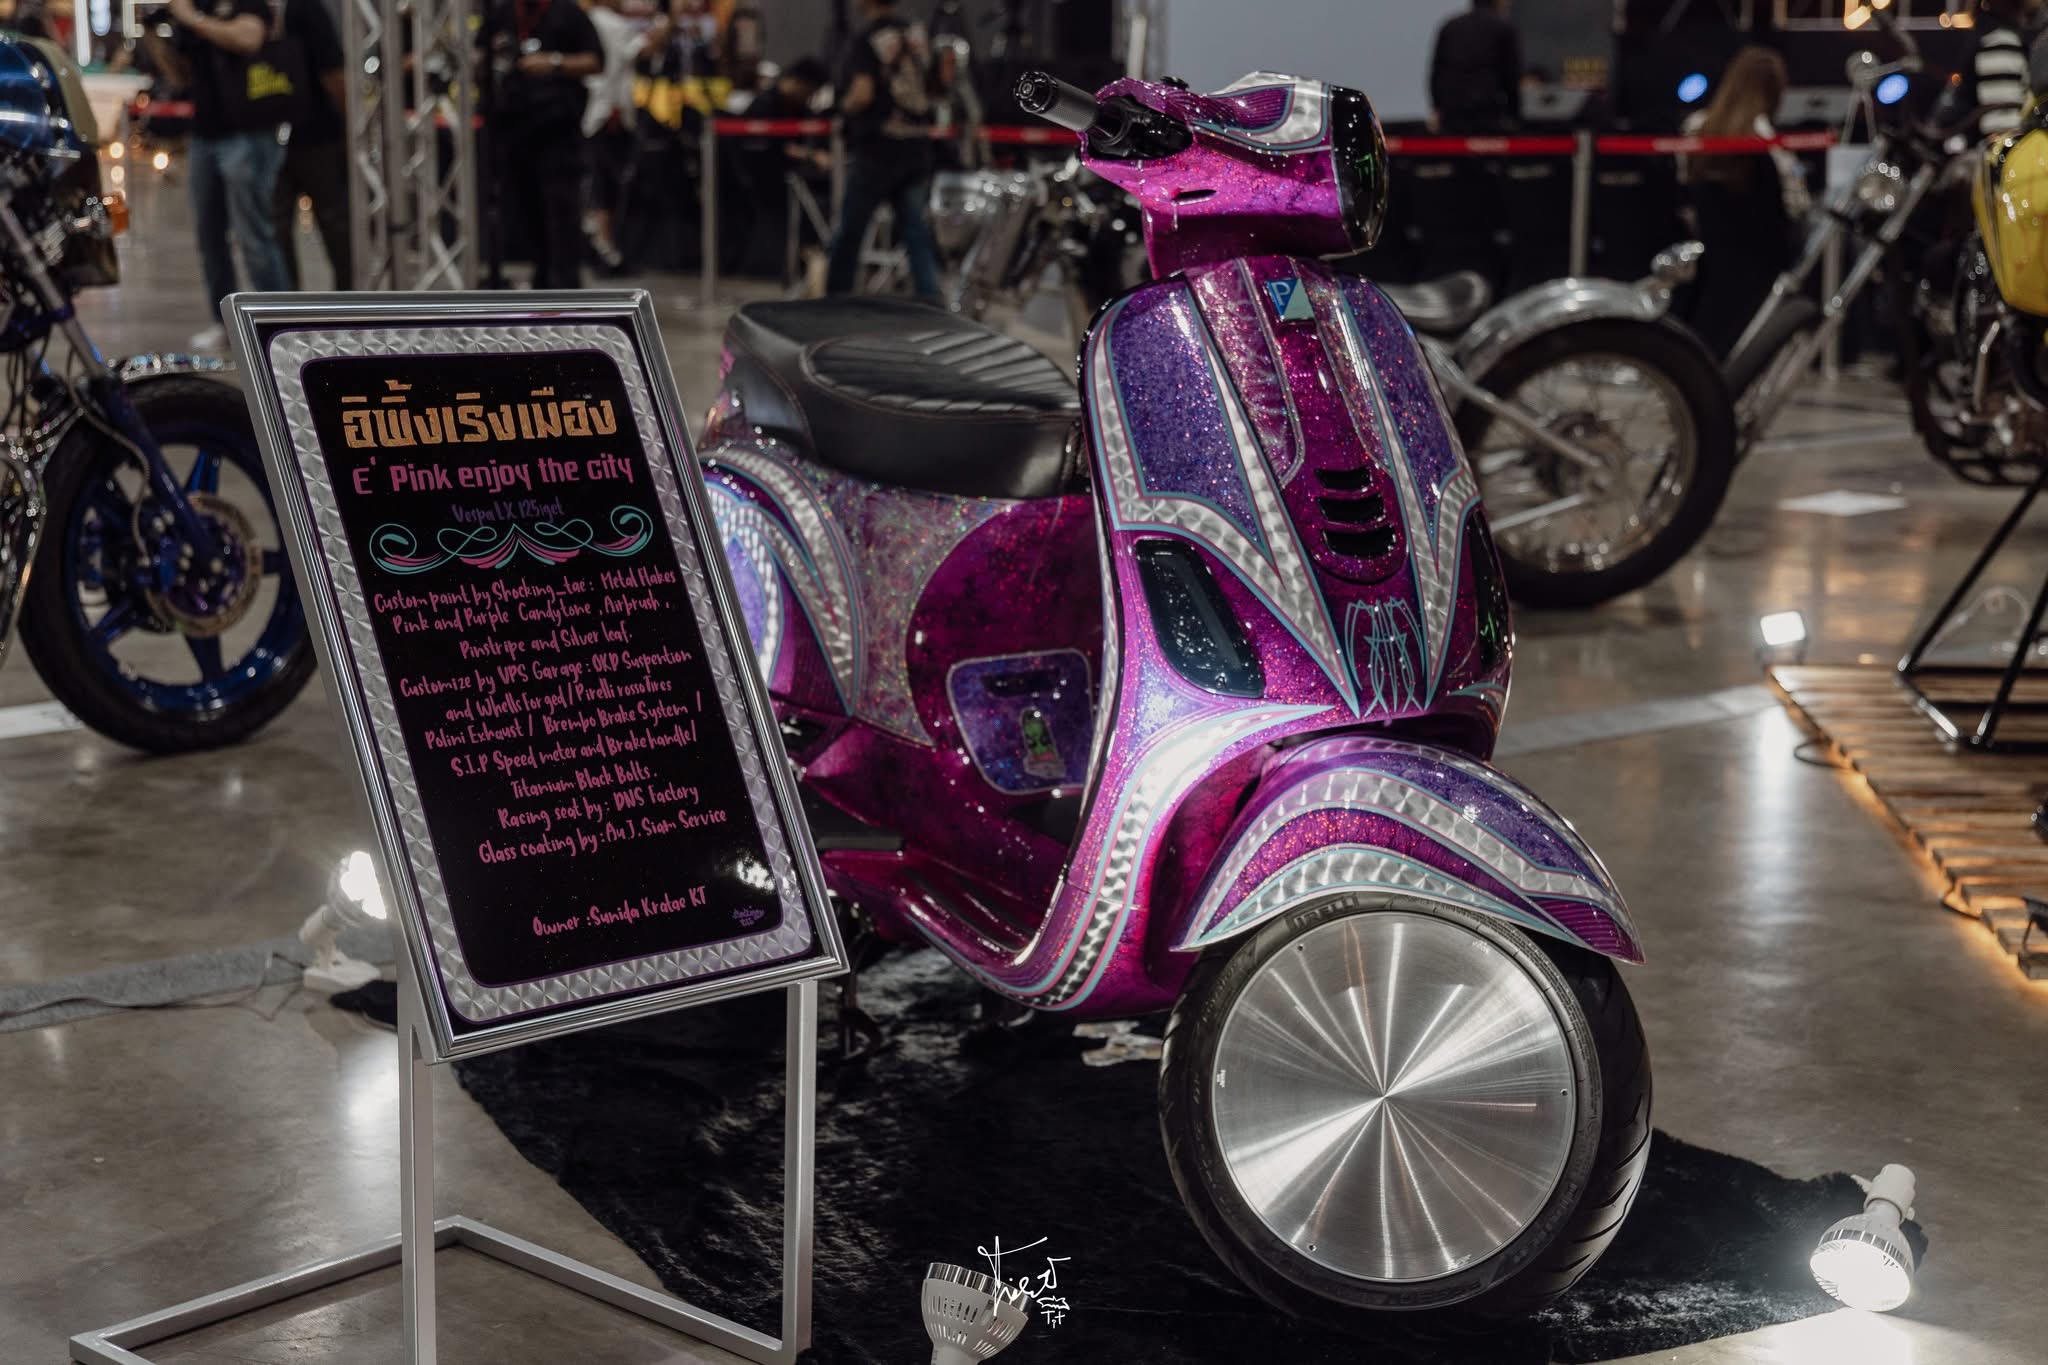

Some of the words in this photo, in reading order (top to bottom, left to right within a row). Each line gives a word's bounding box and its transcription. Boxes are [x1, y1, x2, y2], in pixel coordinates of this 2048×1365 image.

[1271, 281, 1291, 306] P
[389, 463, 453, 491] Pink
[458, 459, 532, 494] enjoy
[538, 457, 580, 483] the
[586, 453, 634, 483] city
[452, 504, 496, 527] Vespa
[494, 501, 517, 520] LX
[374, 589, 428, 613] Custom
[429, 585, 471, 613] paint
[471, 584, 491, 609] by
[600, 567, 638, 590] Metal
[637, 564, 676, 587] Flakes
[392, 611, 429, 634] Pink
[434, 608, 464, 632] and
[464, 603, 509, 632] Purple
[518, 598, 591, 627] Candytone
[459, 636, 525, 661] Pinstripe
[531, 630, 560, 652] and
[560, 625, 599, 648] Silver
[400, 675, 472, 698] Customize
[475, 669, 496, 695] by
[497, 663, 529, 685] VPS
[621, 644, 693, 674] Suspention
[446, 698, 475, 721] and
[476, 692, 523, 718] Whells
[575, 677, 616, 701] Pirelli
[617, 682, 645, 698] rosso
[424, 728, 467, 750] Polini
[467, 717, 524, 744] Exhaust
[542, 712, 597, 735] Brempo
[596, 704, 637, 729] Brake
[637, 699, 689, 727] System
[493, 745, 538, 776] Speed
[538, 741, 577, 764] meter
[580, 733, 607, 758] and
[510, 778, 575, 799] Titanium
[575, 765, 614, 791] Black
[497, 808, 551, 831] Racing
[554, 797, 583, 820] seat
[613, 786, 645, 811] DNS
[648, 781, 700, 805] Factory
[479, 840, 517, 864] Glass
[520, 833, 576, 857] coating
[641, 817, 677, 836] Siam
[678, 809, 727, 829] Service
[532, 916, 580, 936] Owner
[688, 885, 706, 907] KT
